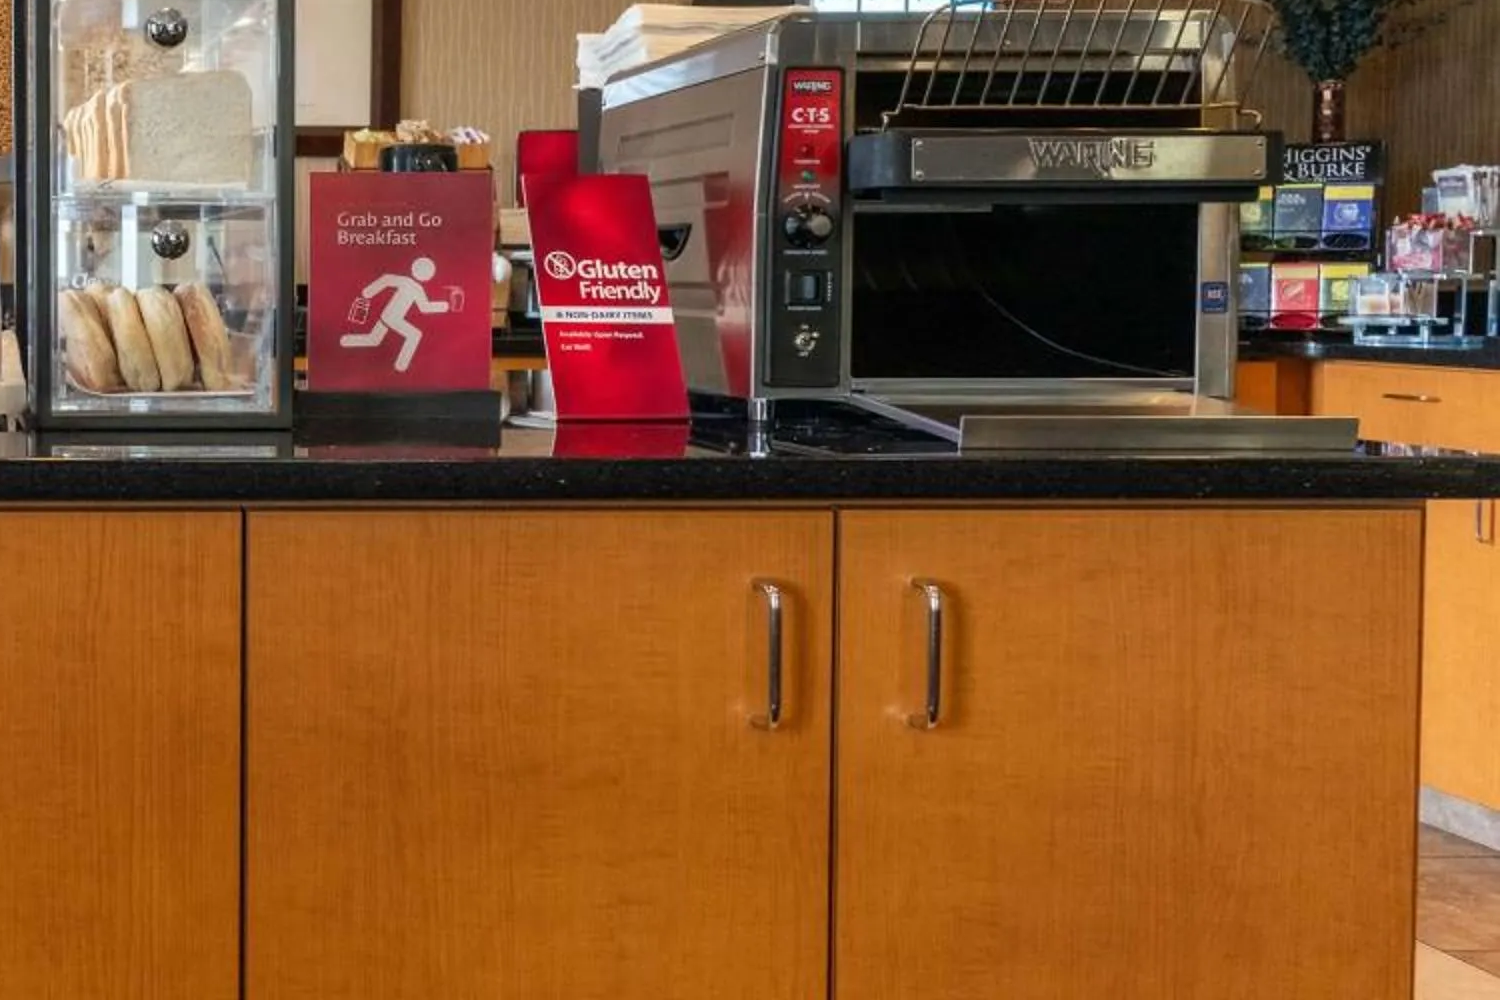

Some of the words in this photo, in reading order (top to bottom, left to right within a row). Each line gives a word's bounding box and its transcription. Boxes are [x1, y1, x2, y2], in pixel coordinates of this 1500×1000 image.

[1298, 161, 1365, 178] BURKE
[337, 211, 377, 228] Grab
[382, 211, 414, 228] and
[419, 212, 443, 228] Go
[337, 229, 417, 246] Breakfast
[577, 259, 659, 280] Gluten
[580, 281, 661, 305] Friendly
